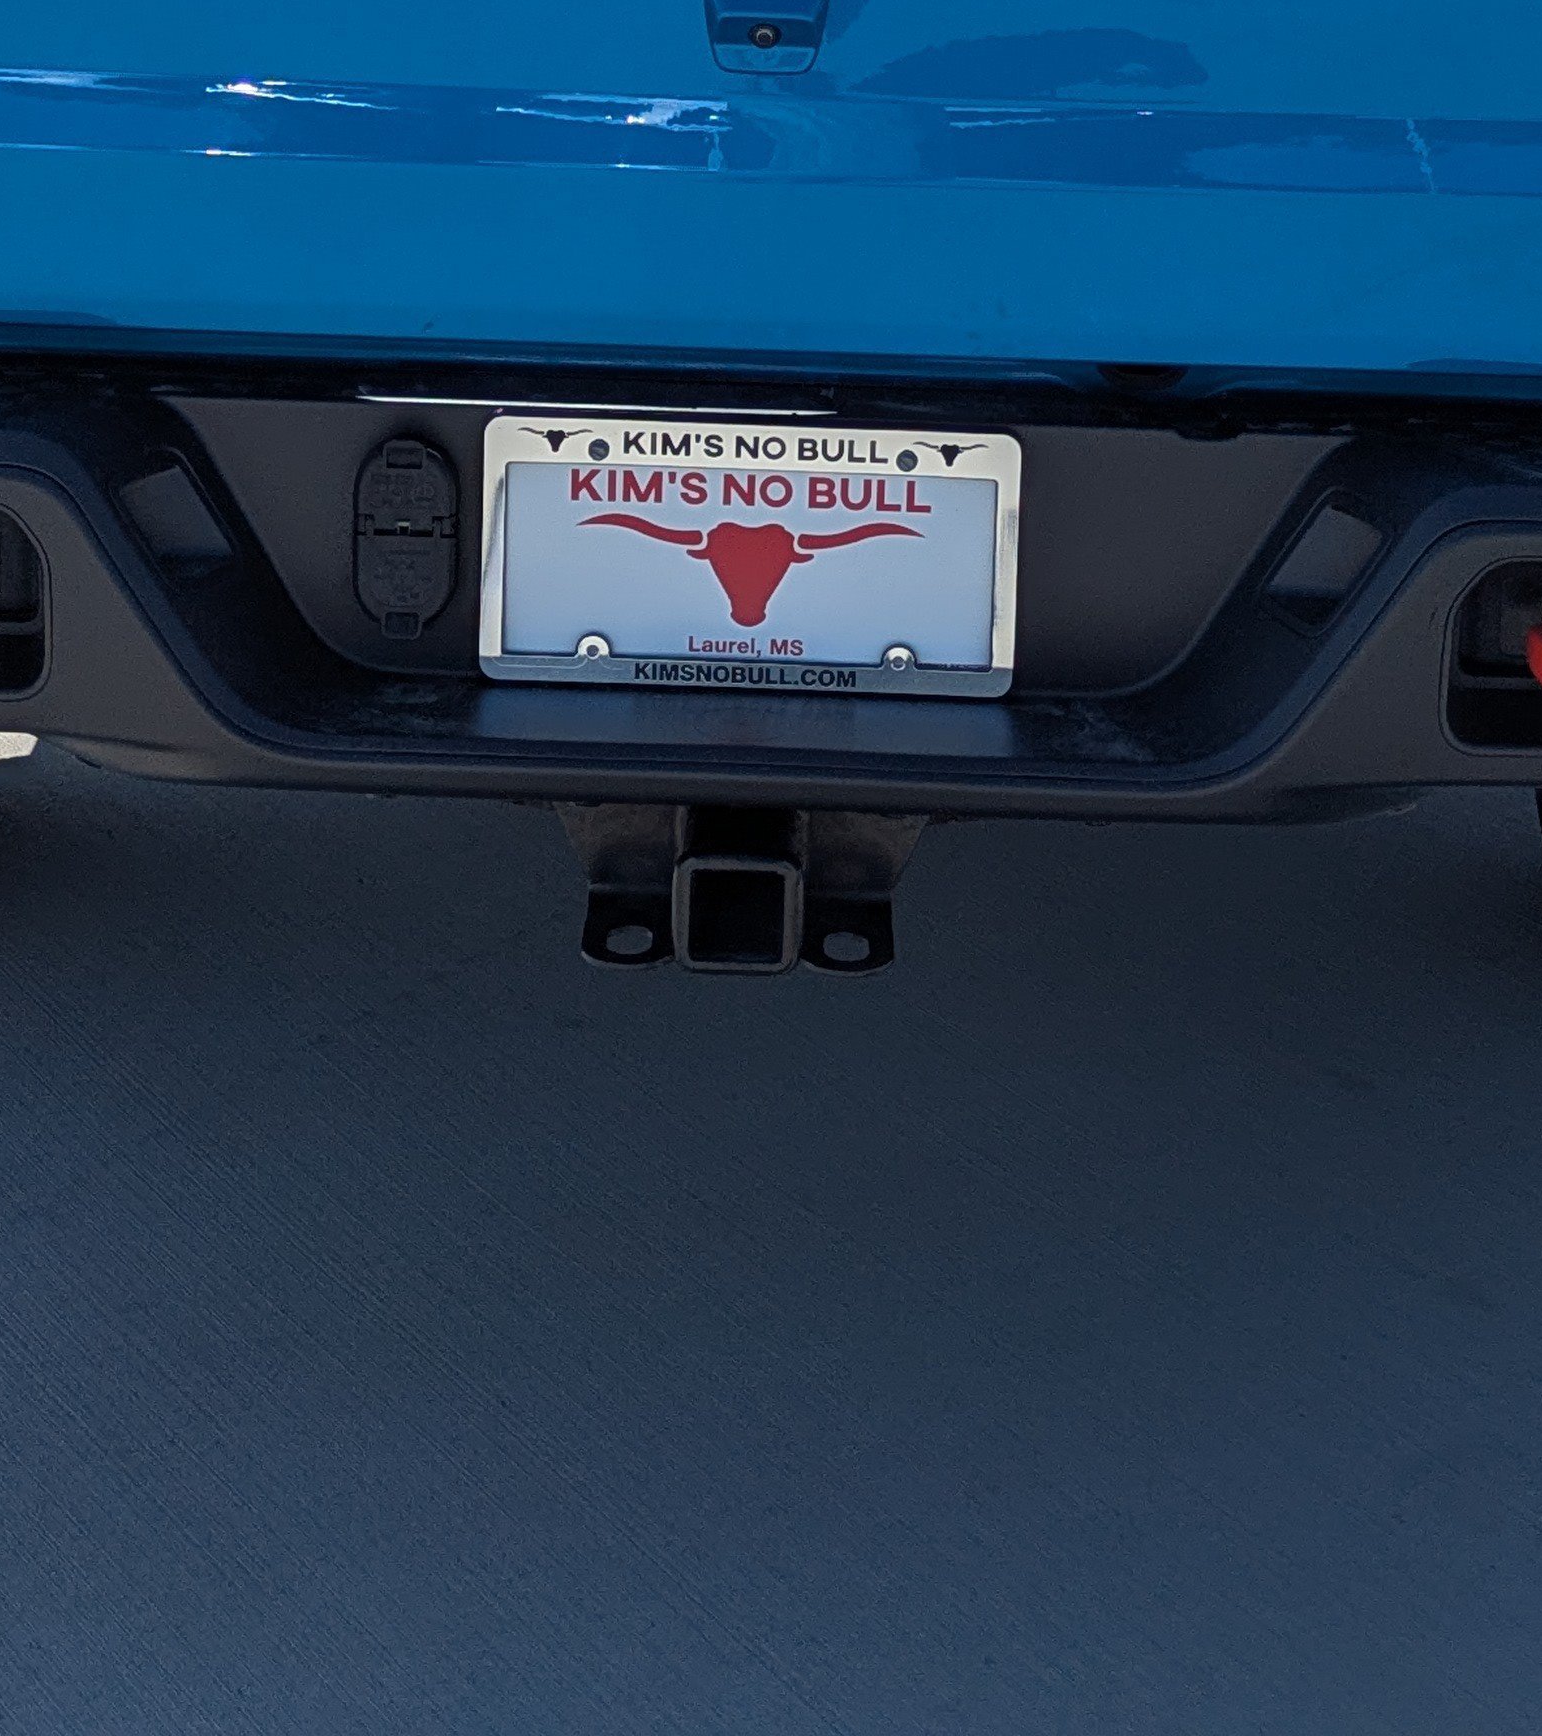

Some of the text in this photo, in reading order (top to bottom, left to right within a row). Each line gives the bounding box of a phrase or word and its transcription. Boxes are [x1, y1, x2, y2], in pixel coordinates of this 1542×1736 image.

[622, 431, 889, 464] KIM'S NO BULL
[570, 467, 932, 513] KIM'S NO BULL
[687, 635, 804, 657] Laurel, MS
[633, 662, 857, 689] KIMSNOBULL.COM
